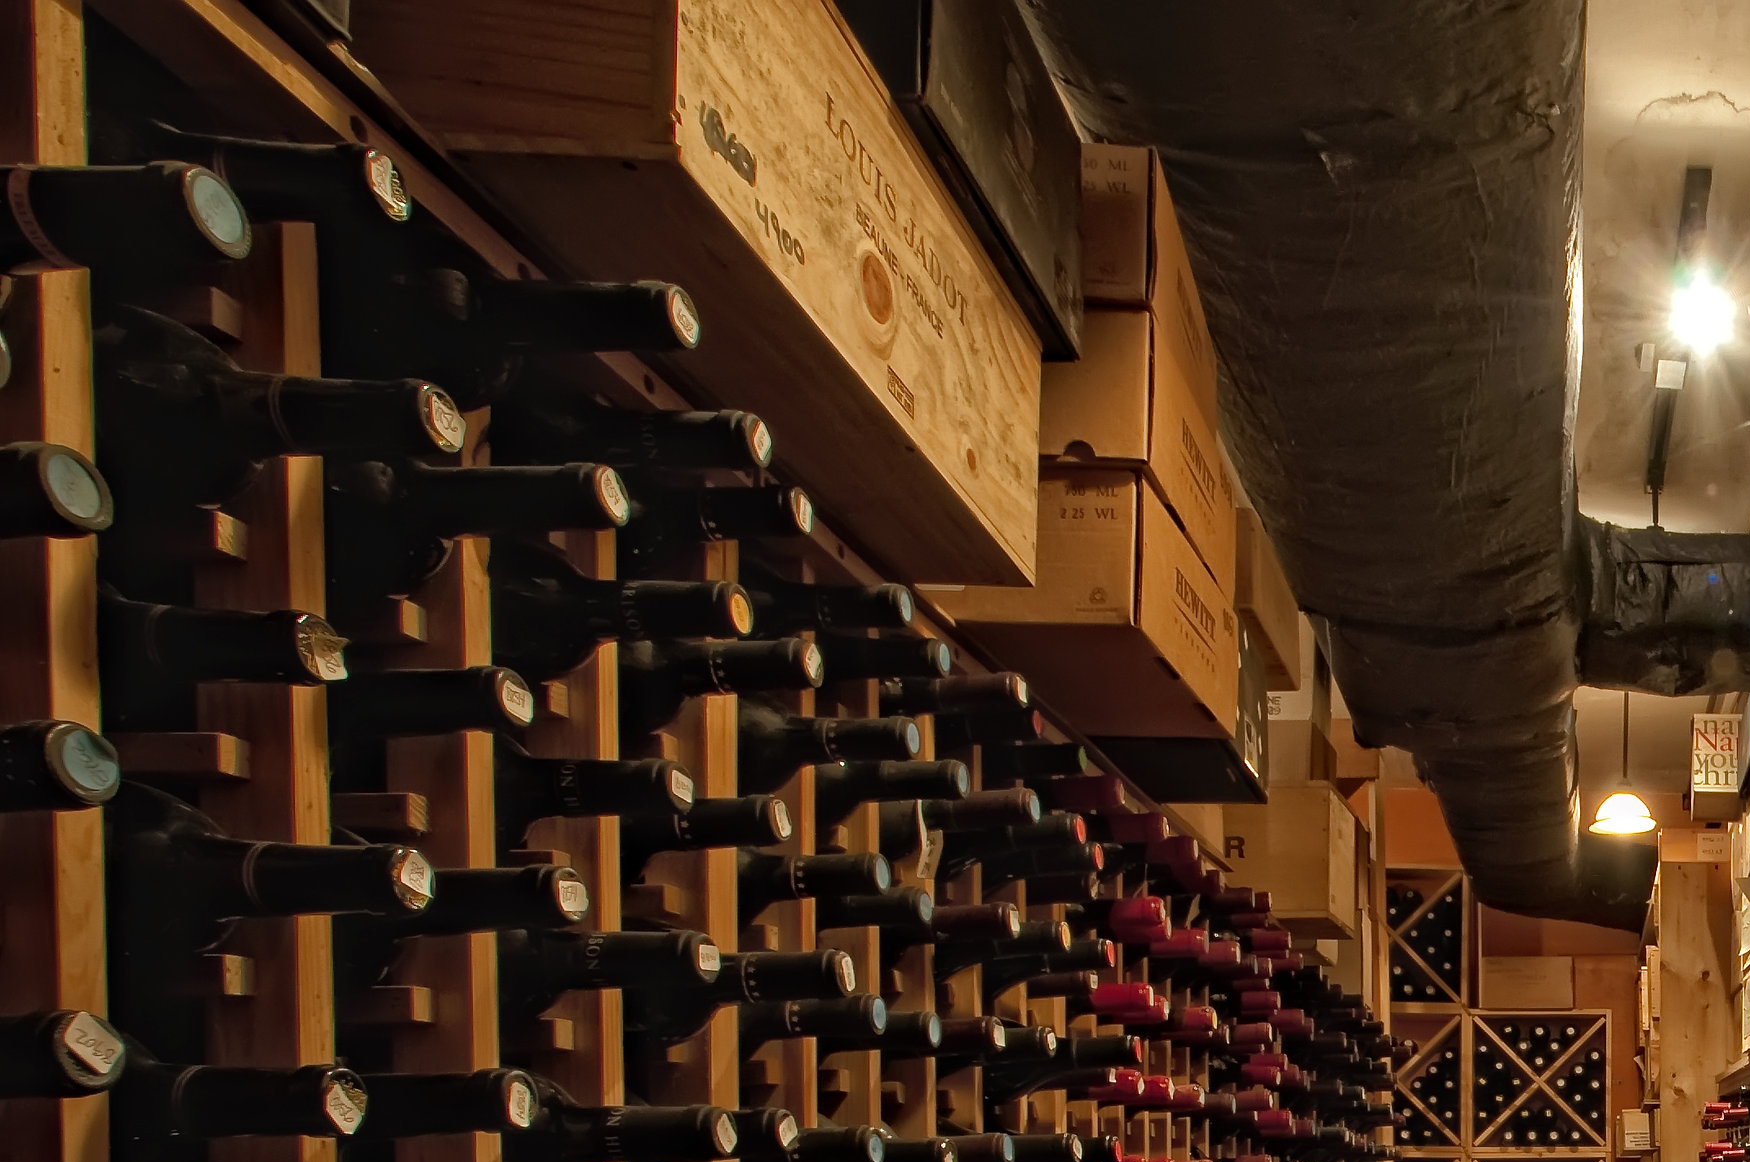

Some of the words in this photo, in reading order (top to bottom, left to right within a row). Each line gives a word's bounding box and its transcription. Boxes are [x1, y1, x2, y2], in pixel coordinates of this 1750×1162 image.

[824, 91, 897, 223] LOUIS
[903, 217, 968, 327] JADOT
[855, 201, 899, 277] BEAUNE
[906, 273, 944, 340] FRANCE
[1182, 417, 1216, 503] HEWITT
[1096, 508, 1119, 521] WL
[1175, 566, 1217, 643] HEWITT
[1693, 727, 1738, 760] Na
